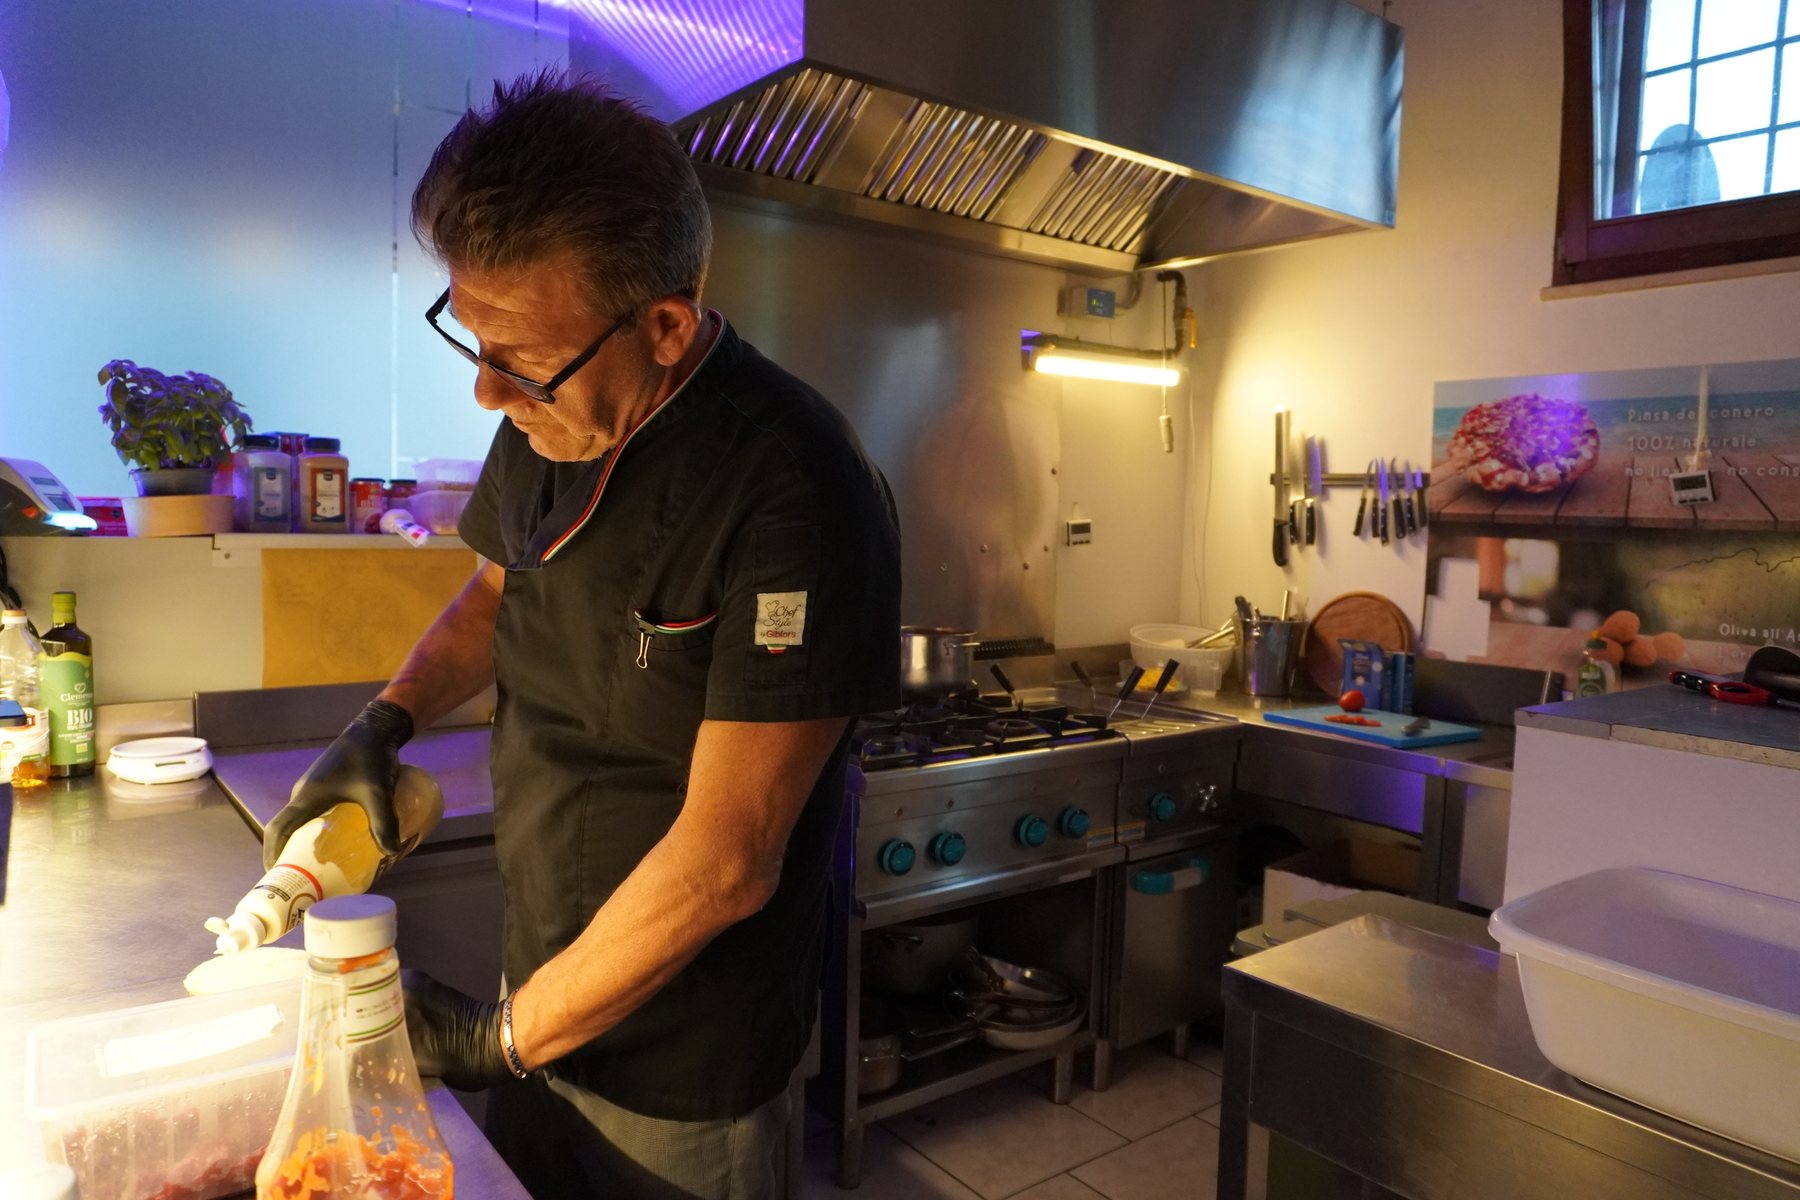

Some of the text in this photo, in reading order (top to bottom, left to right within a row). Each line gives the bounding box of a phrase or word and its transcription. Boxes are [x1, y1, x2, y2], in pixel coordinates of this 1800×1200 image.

[1628, 406, 1775, 423] Pinsa de conero
[1683, 434, 1757, 448] nurale
[1625, 465, 1643, 477] no
[1727, 465, 1748, 477] no
[775, 604, 802, 618] Chef
[763, 617, 791, 628] Style
[1720, 623, 1757, 637] Oliva
[67, 708, 93, 725] BIO
